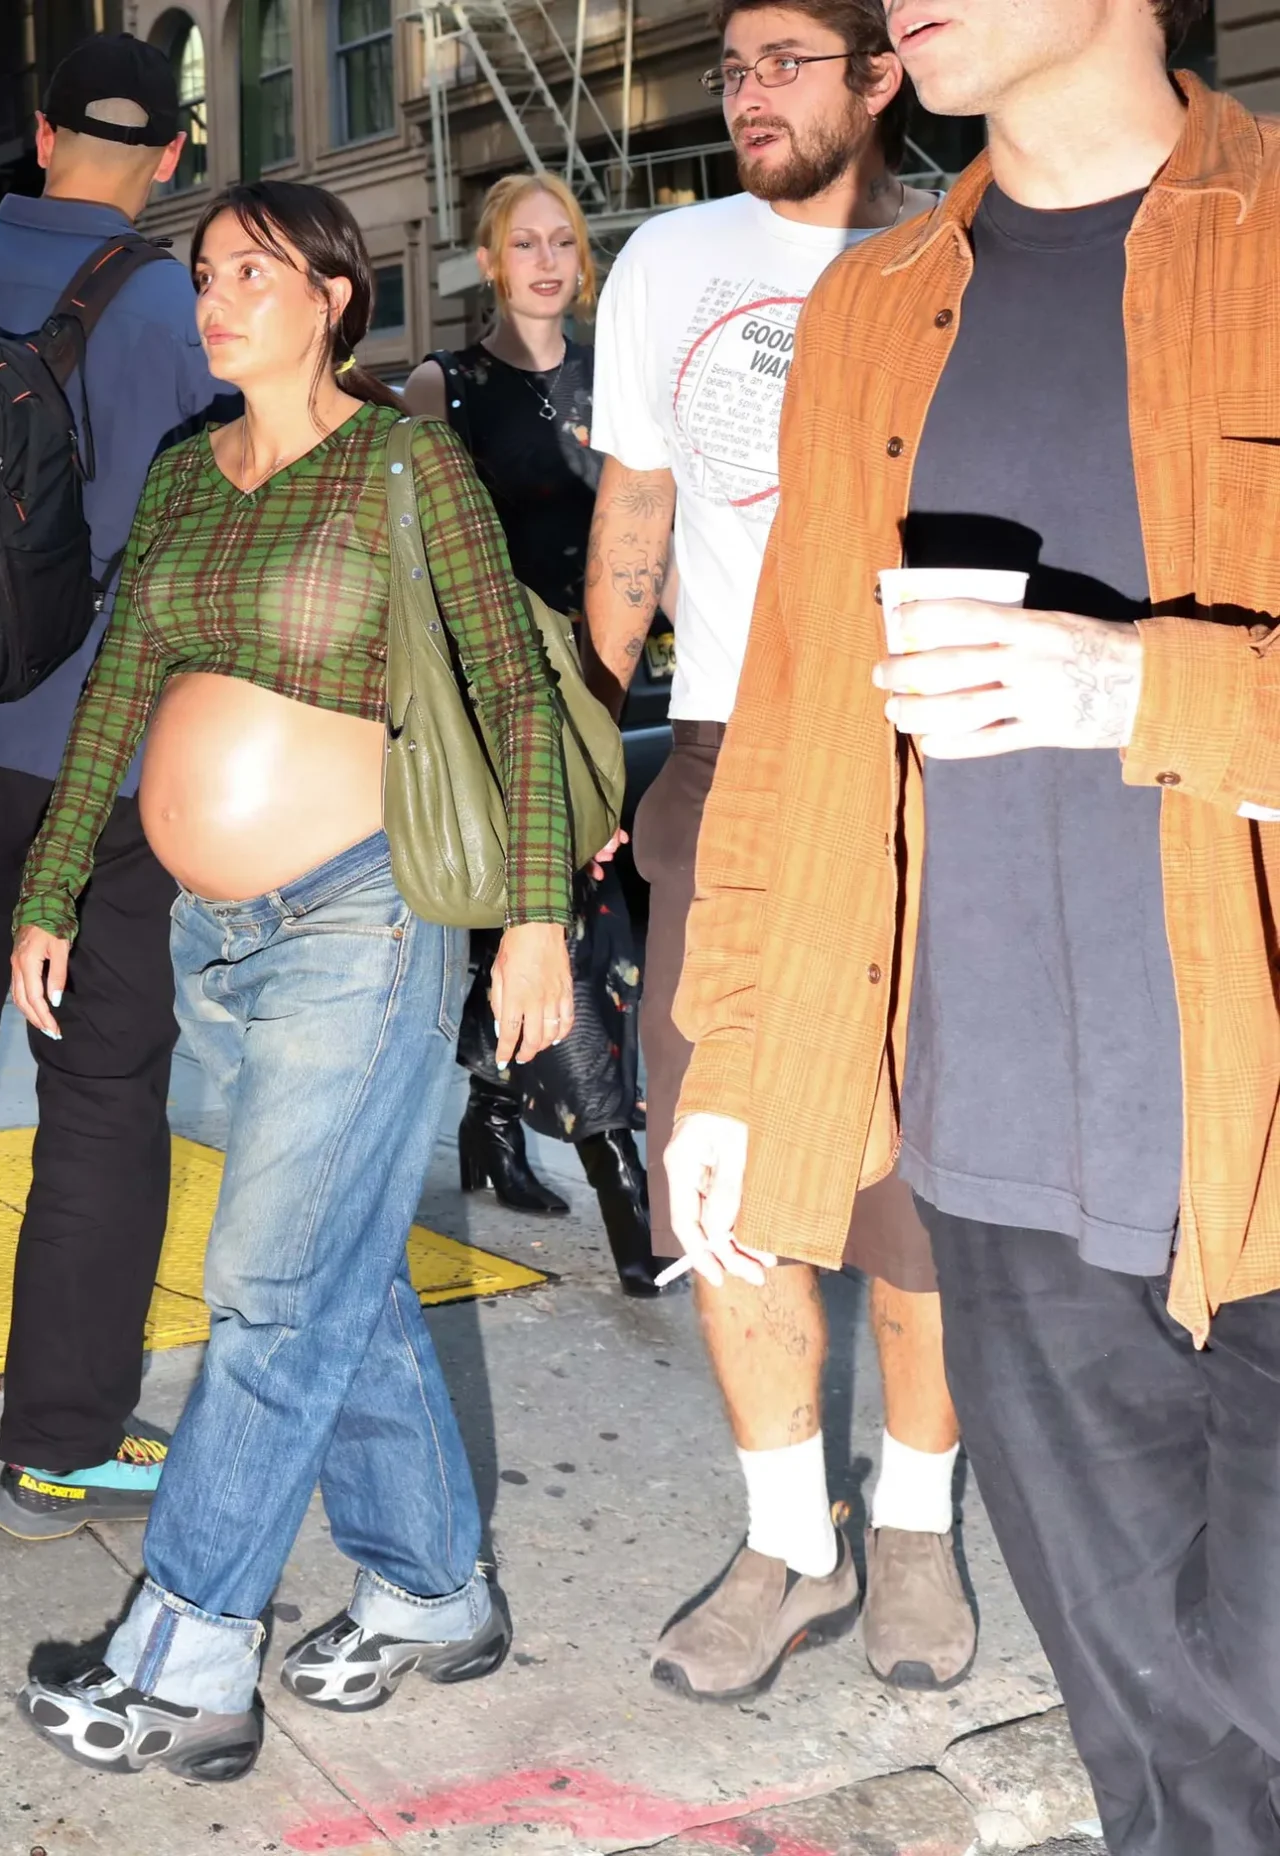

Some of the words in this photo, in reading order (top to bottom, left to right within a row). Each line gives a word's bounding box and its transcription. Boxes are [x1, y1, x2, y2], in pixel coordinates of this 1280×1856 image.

[741, 320, 795, 353] GOOD
[711, 363, 747, 383] Seeking
[750, 376, 763, 385] an
[740, 384, 757, 397] free
[761, 392, 772, 401] of
[707, 416, 735, 430] planet
[728, 406, 750, 420] Must
[753, 415, 766, 425] be
[754, 441, 773, 453] and
